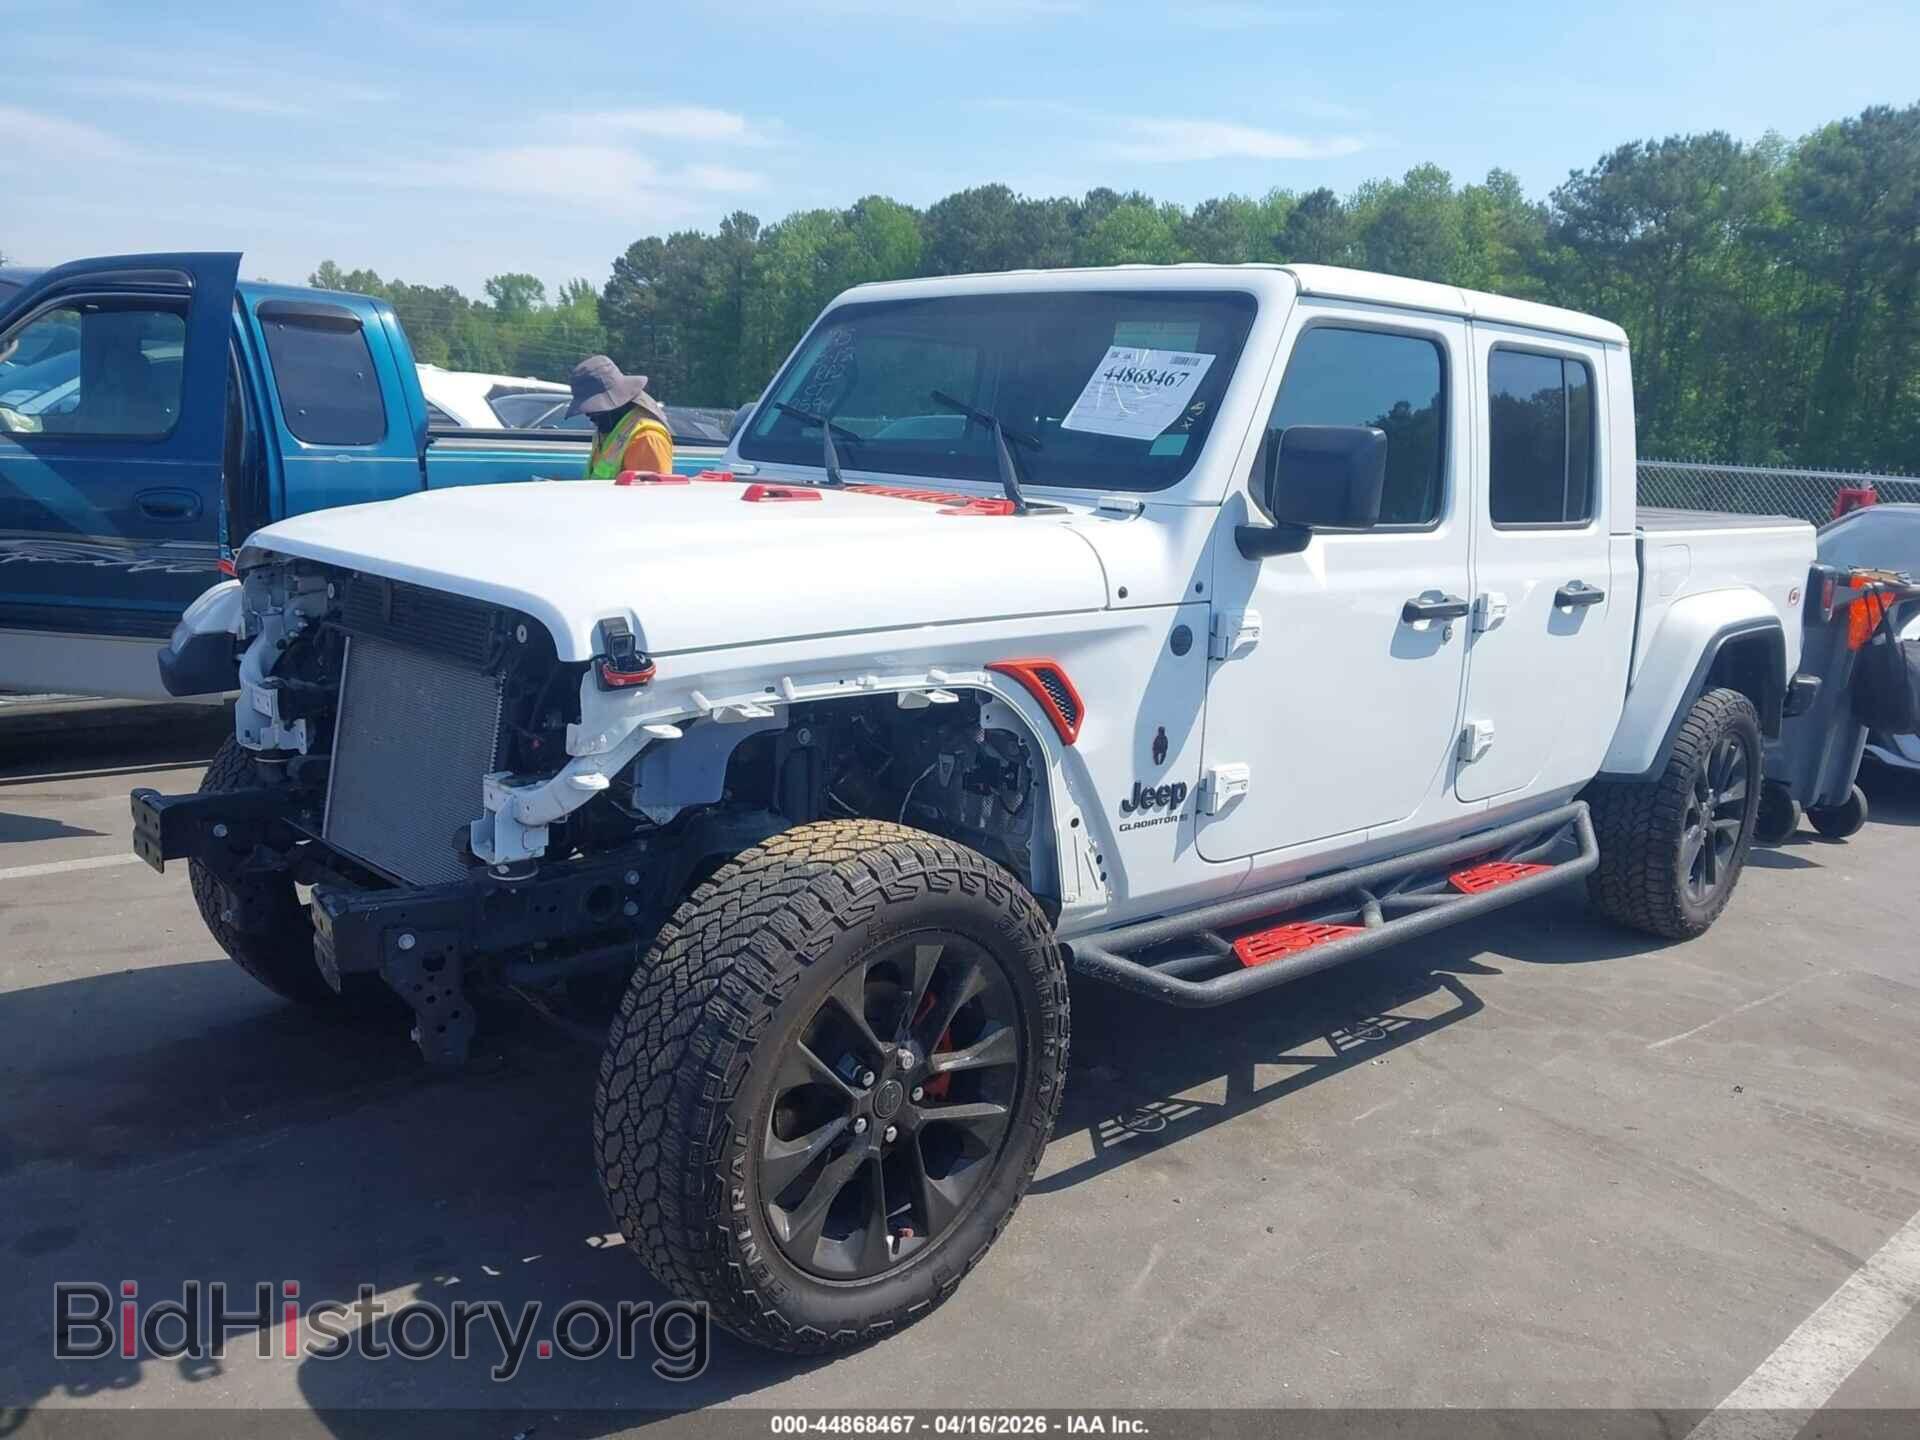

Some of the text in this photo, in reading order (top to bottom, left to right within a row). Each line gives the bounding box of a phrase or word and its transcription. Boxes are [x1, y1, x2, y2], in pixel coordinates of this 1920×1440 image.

[1103, 366, 1190, 387] 44868467
[1121, 781, 1187, 813] Jeep
[1119, 815, 1178, 831] GLADIATOR
